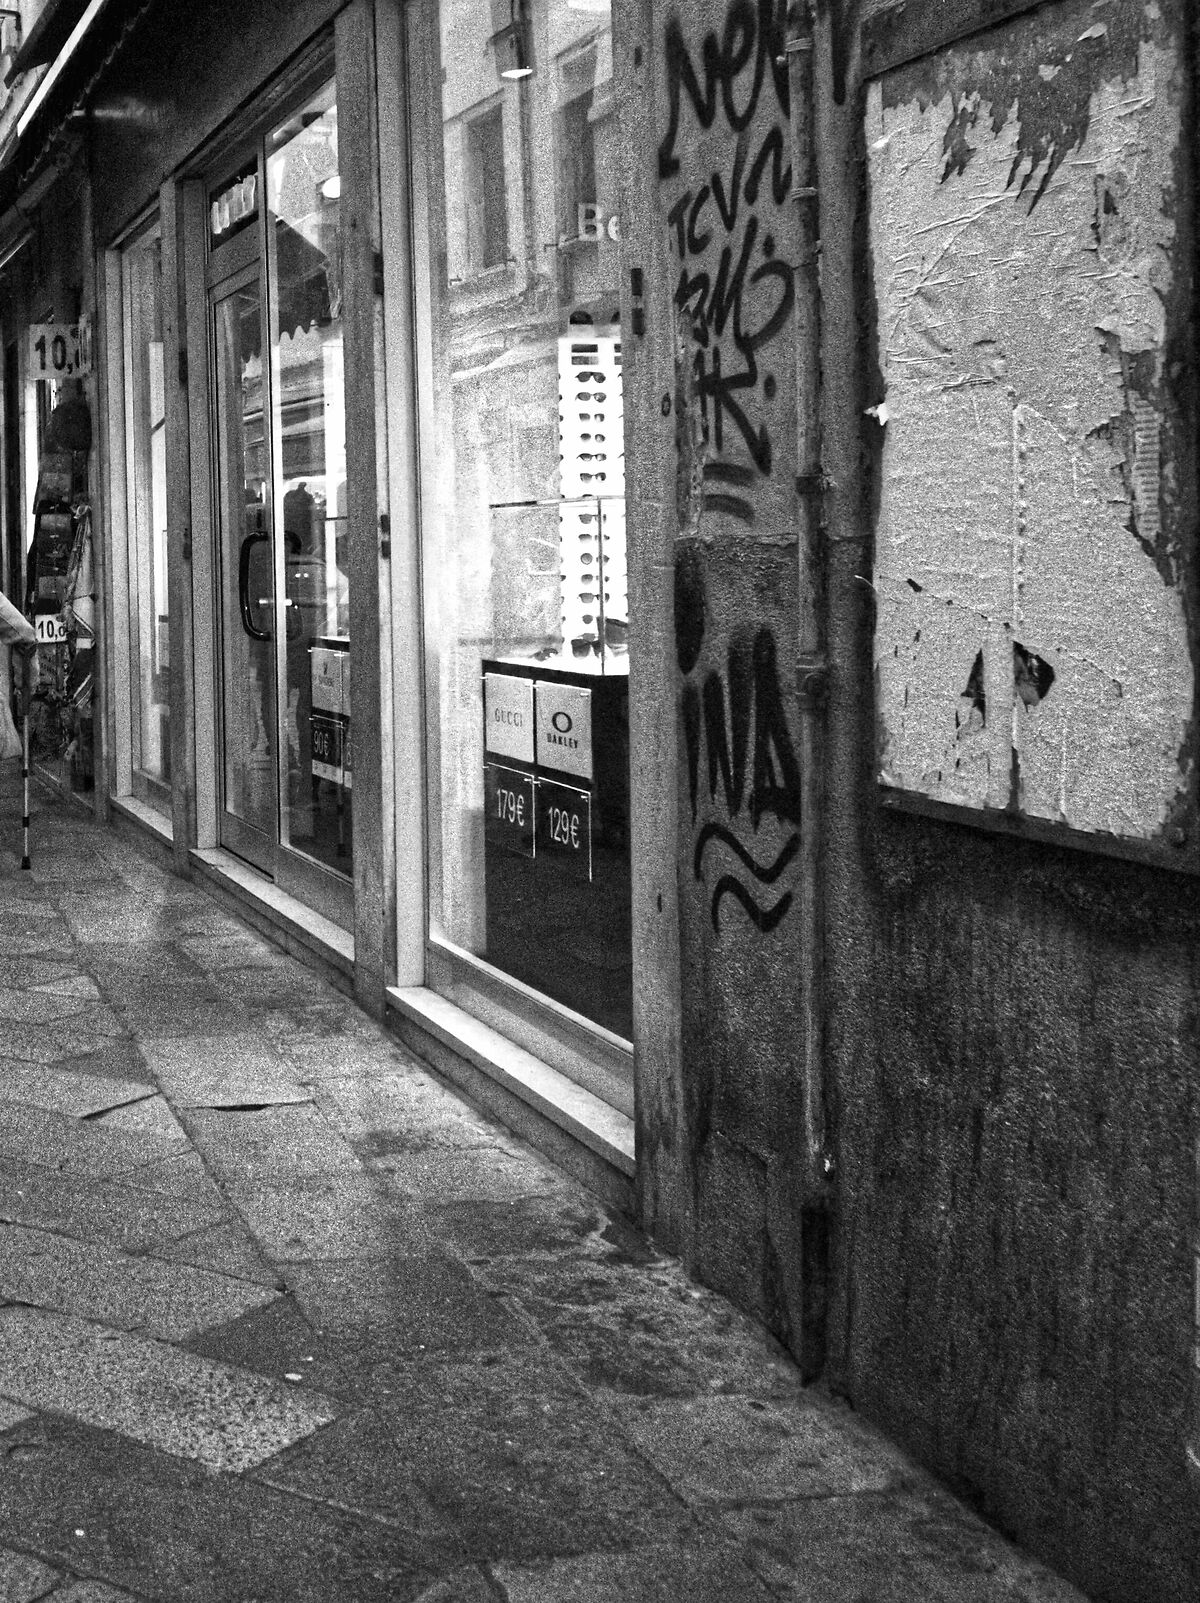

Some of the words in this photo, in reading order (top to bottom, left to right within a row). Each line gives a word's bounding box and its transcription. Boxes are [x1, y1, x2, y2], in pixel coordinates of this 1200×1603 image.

[494, 707, 523, 728] GUCCI
[496, 788, 525, 827] 179€
[548, 806, 580, 849] 129€
